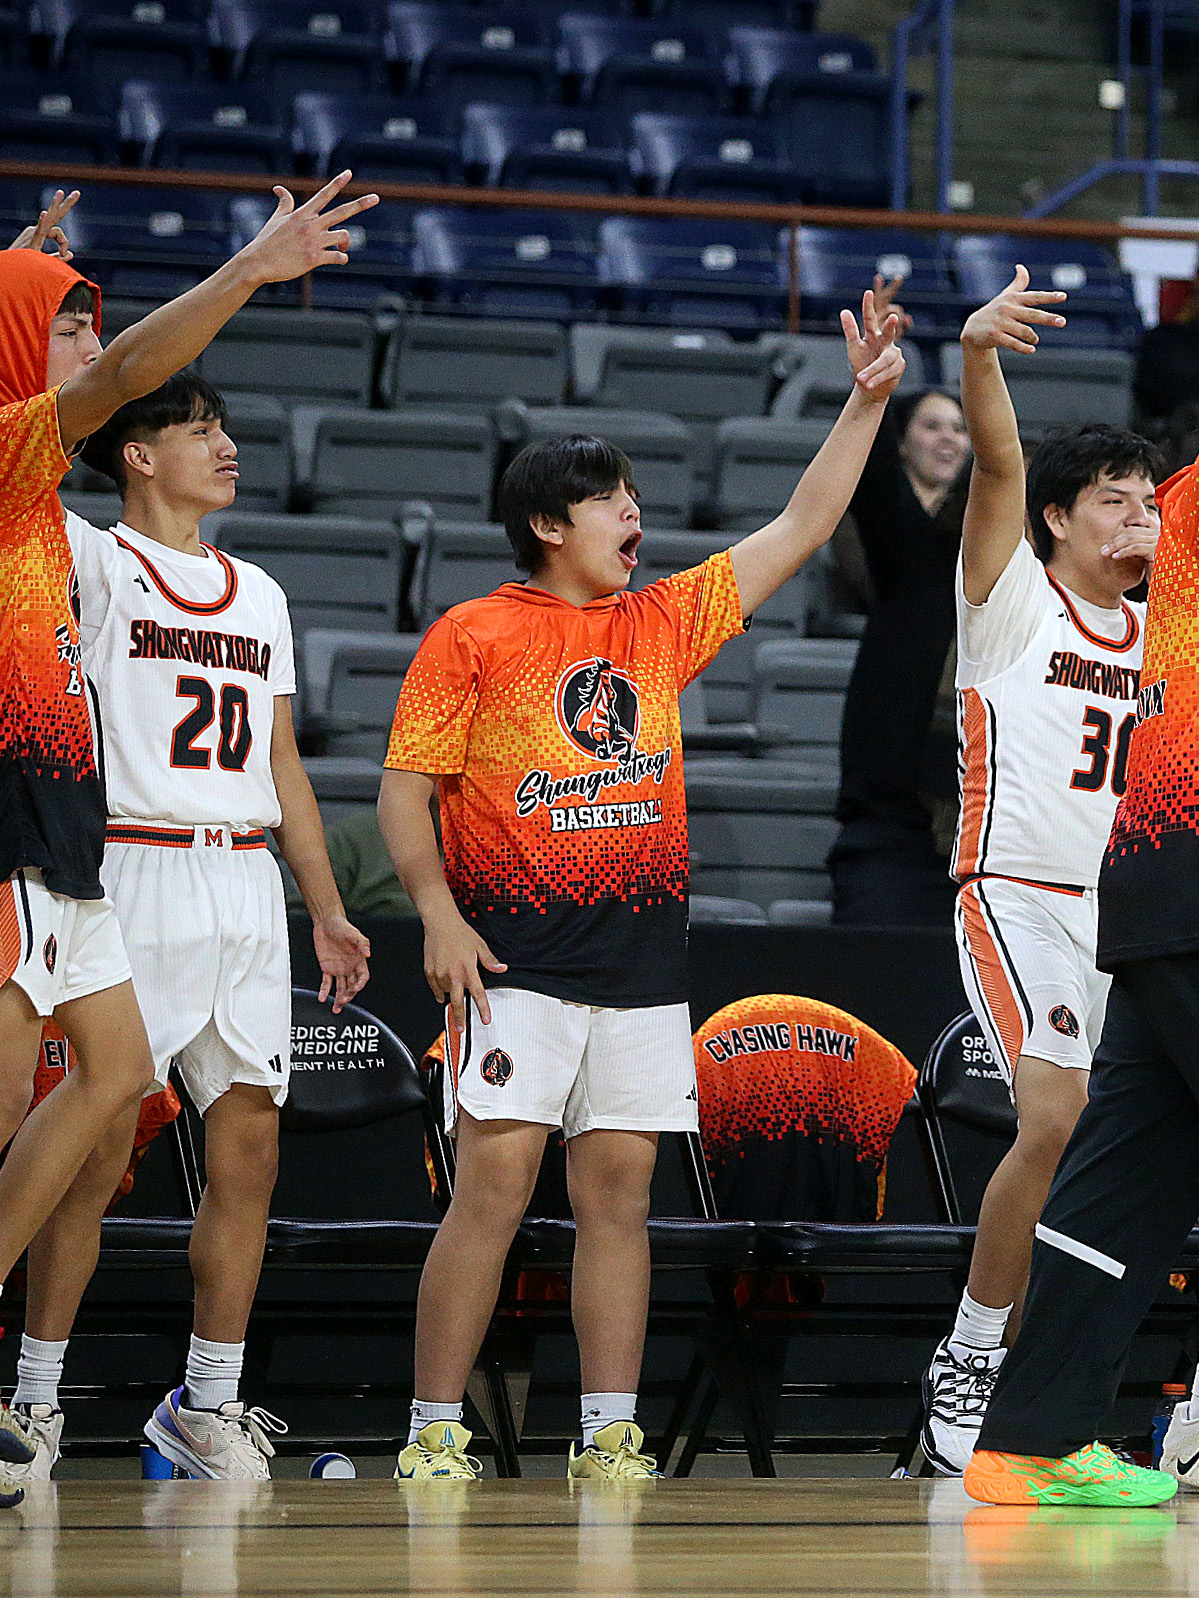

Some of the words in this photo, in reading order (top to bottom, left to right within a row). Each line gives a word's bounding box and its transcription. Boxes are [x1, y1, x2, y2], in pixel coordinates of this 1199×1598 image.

[170, 675, 252, 772] 20
[204, 828, 223, 847] M
[340, 1025, 379, 1039] AND
[290, 1039, 379, 1055] MEDICINE
[797, 1024, 858, 1062] HAWK
[326, 1058, 385, 1071] HEALTH
